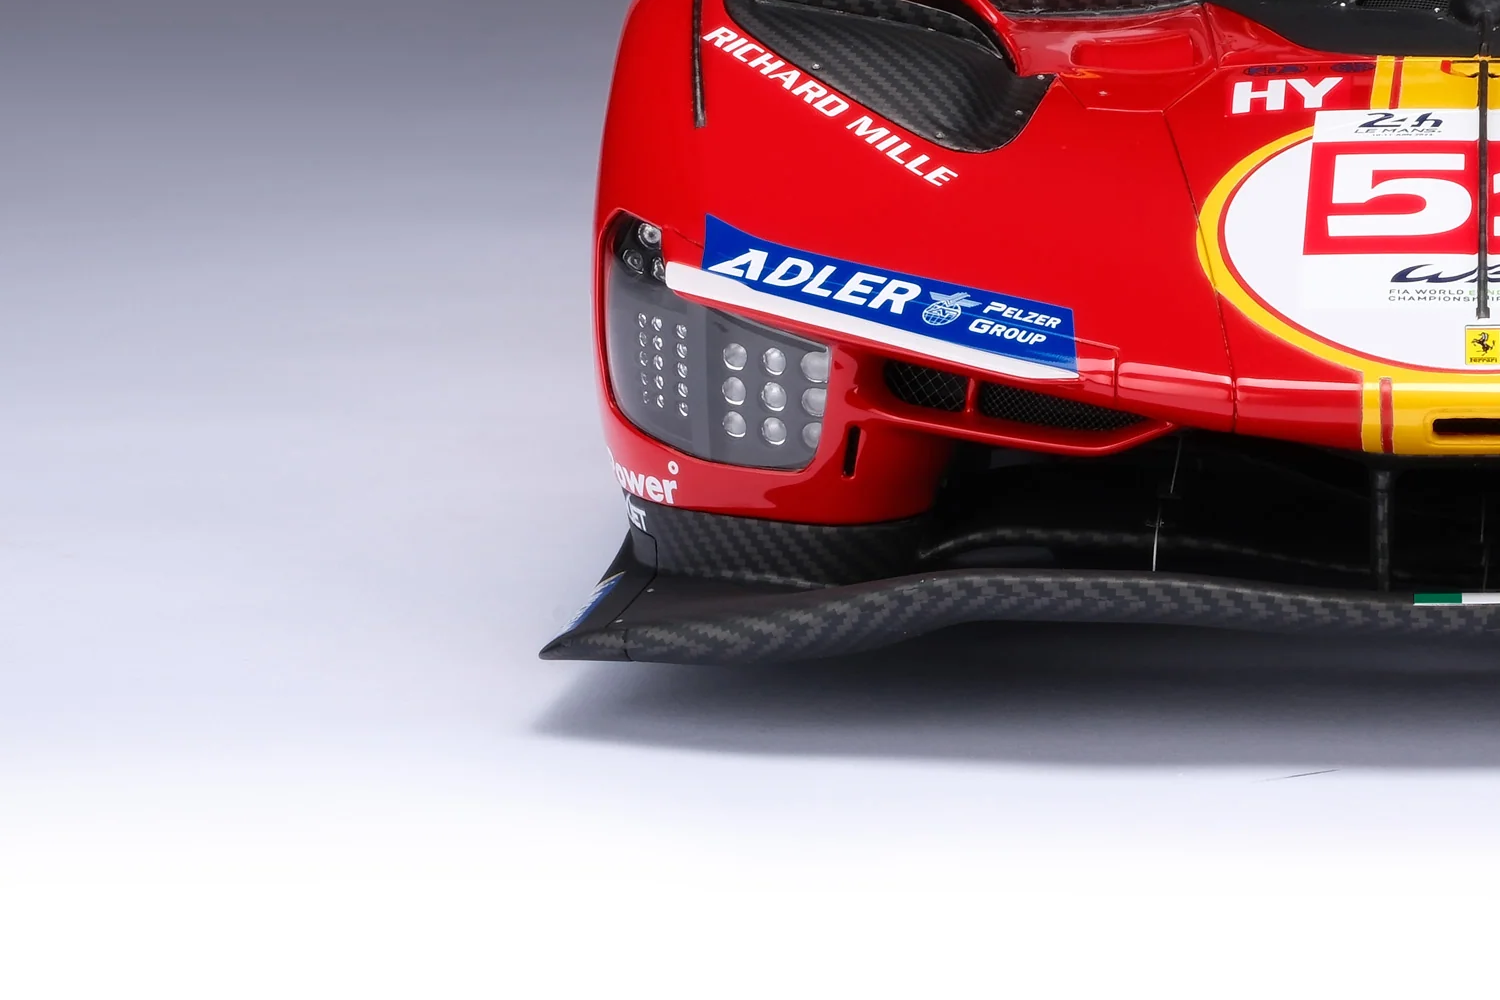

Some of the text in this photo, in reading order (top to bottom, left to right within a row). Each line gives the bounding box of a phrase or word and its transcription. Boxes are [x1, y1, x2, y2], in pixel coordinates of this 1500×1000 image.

[702, 26, 959, 187] RICHARD MILLE
[1232, 77, 1343, 114] HY
[708, 248, 922, 315] ADLER
